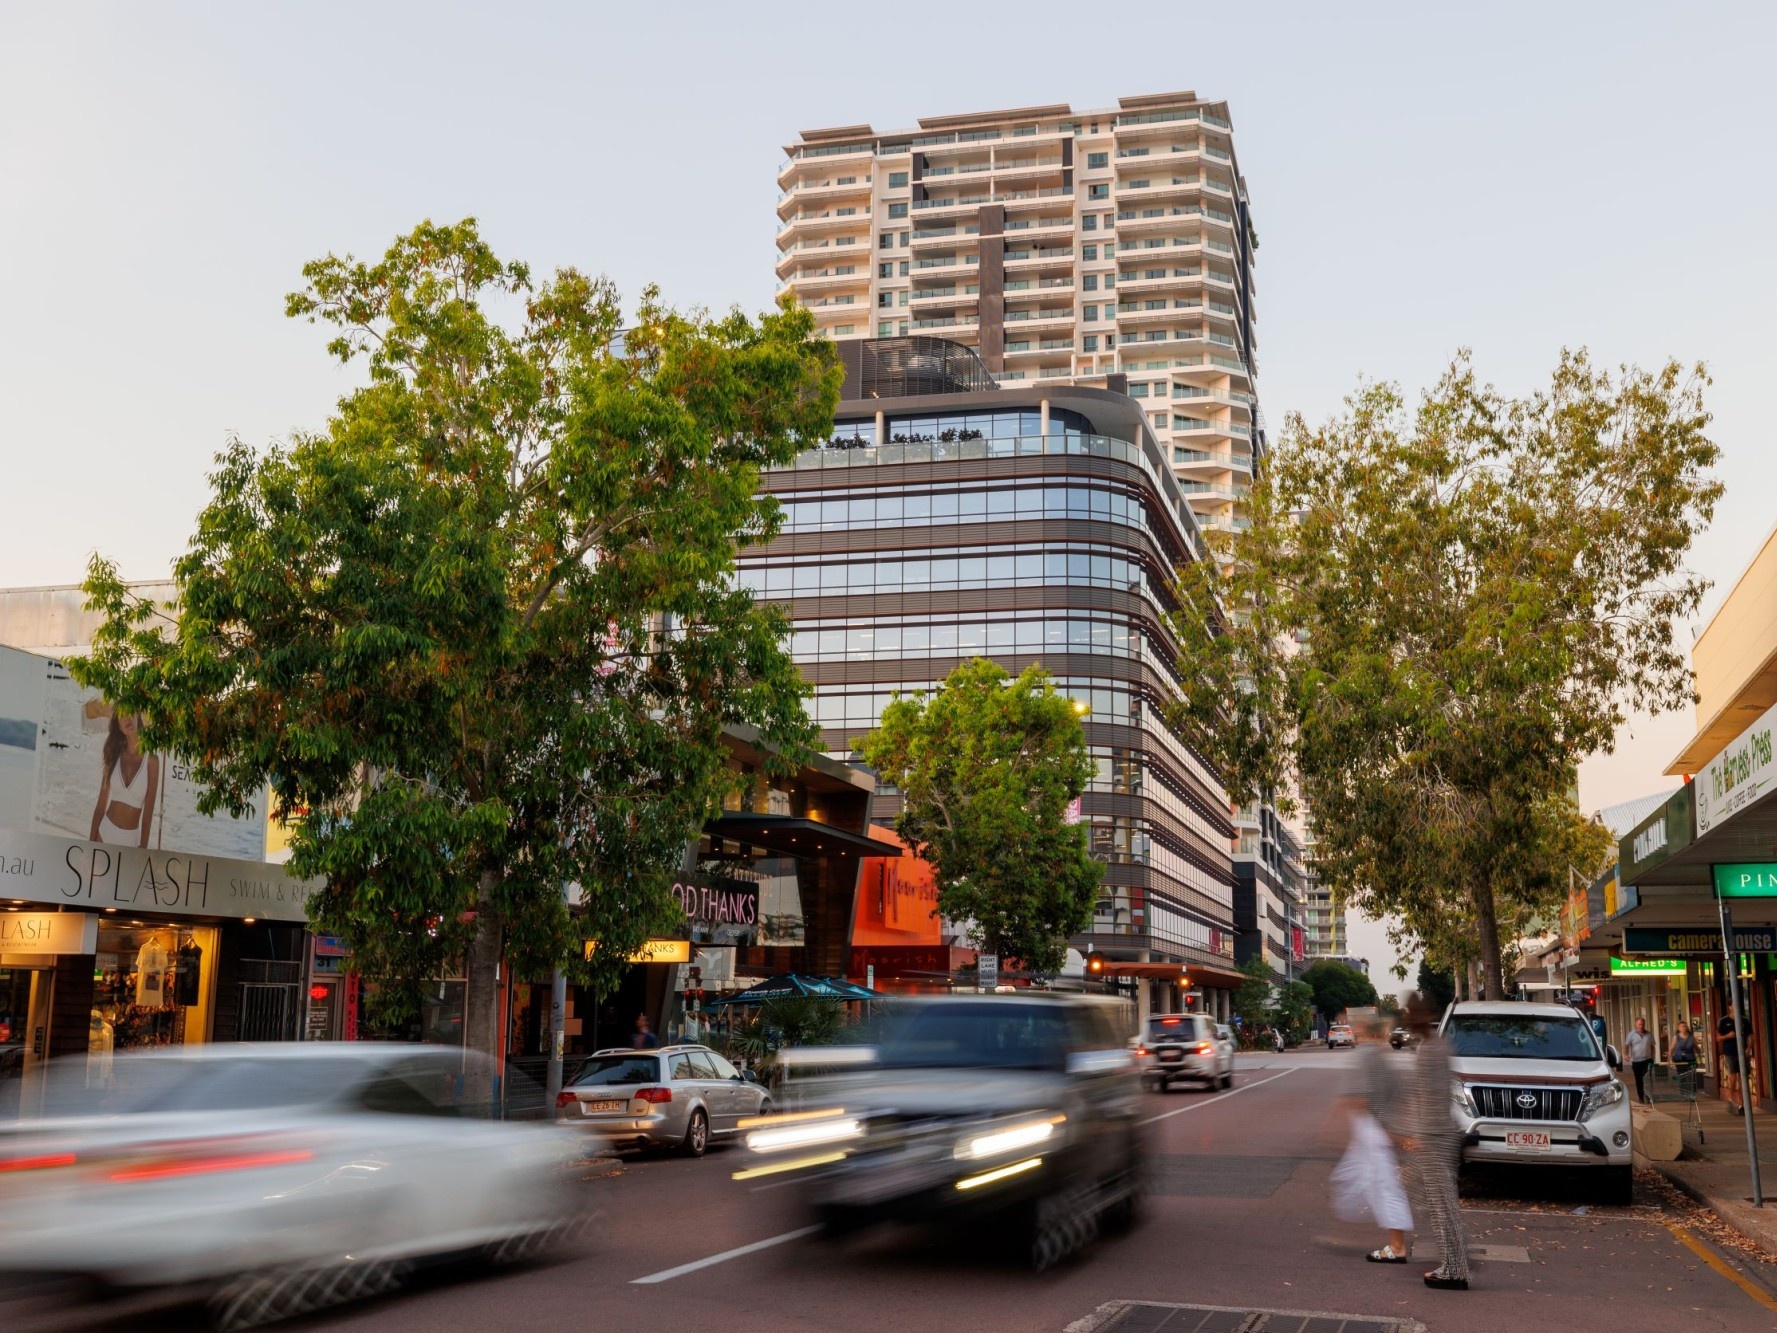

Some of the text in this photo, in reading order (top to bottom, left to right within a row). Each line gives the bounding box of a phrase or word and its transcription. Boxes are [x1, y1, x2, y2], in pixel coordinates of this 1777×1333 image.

[1751, 729, 1772, 774] Press
[61, 845, 209, 908] SPLASH
[229, 878, 270, 901] SWIM
[276, 883, 285, 902] &
[701, 888, 755, 924] THANKS
[1, 919, 52, 940] LASH
[1575, 967, 1611, 979] wis
[1507, 1133, 1549, 1145] CC 90 ZA
